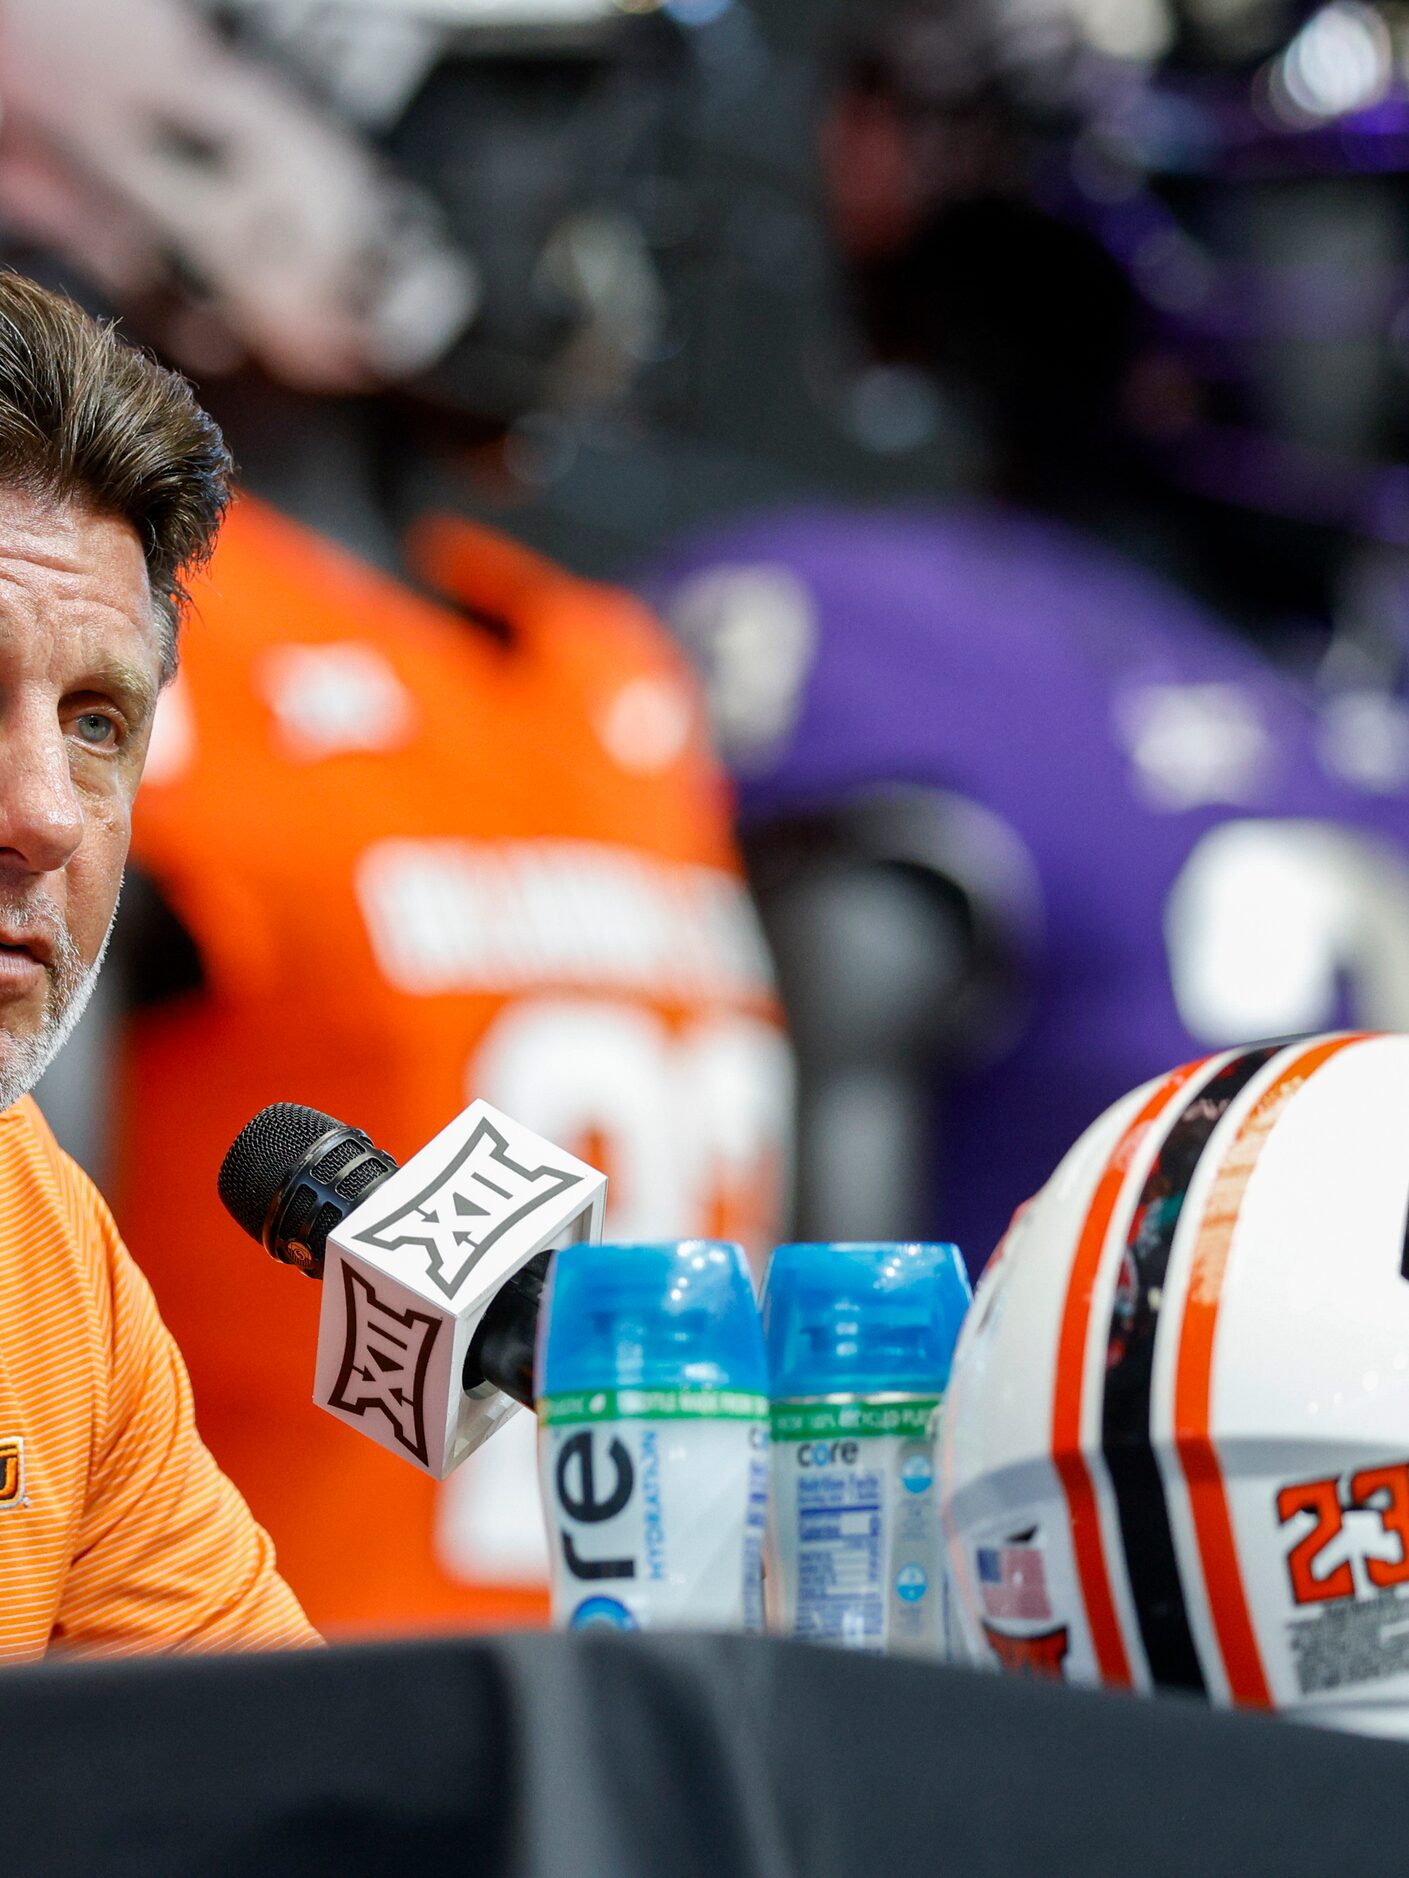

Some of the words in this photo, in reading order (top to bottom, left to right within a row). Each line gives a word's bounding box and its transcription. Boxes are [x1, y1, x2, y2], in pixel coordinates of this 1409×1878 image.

[352, 1116, 585, 1299] XII
[327, 1258, 443, 1467] XII
[641, 1430, 665, 1580] HYDRATION
[797, 1440, 859, 1468] core
